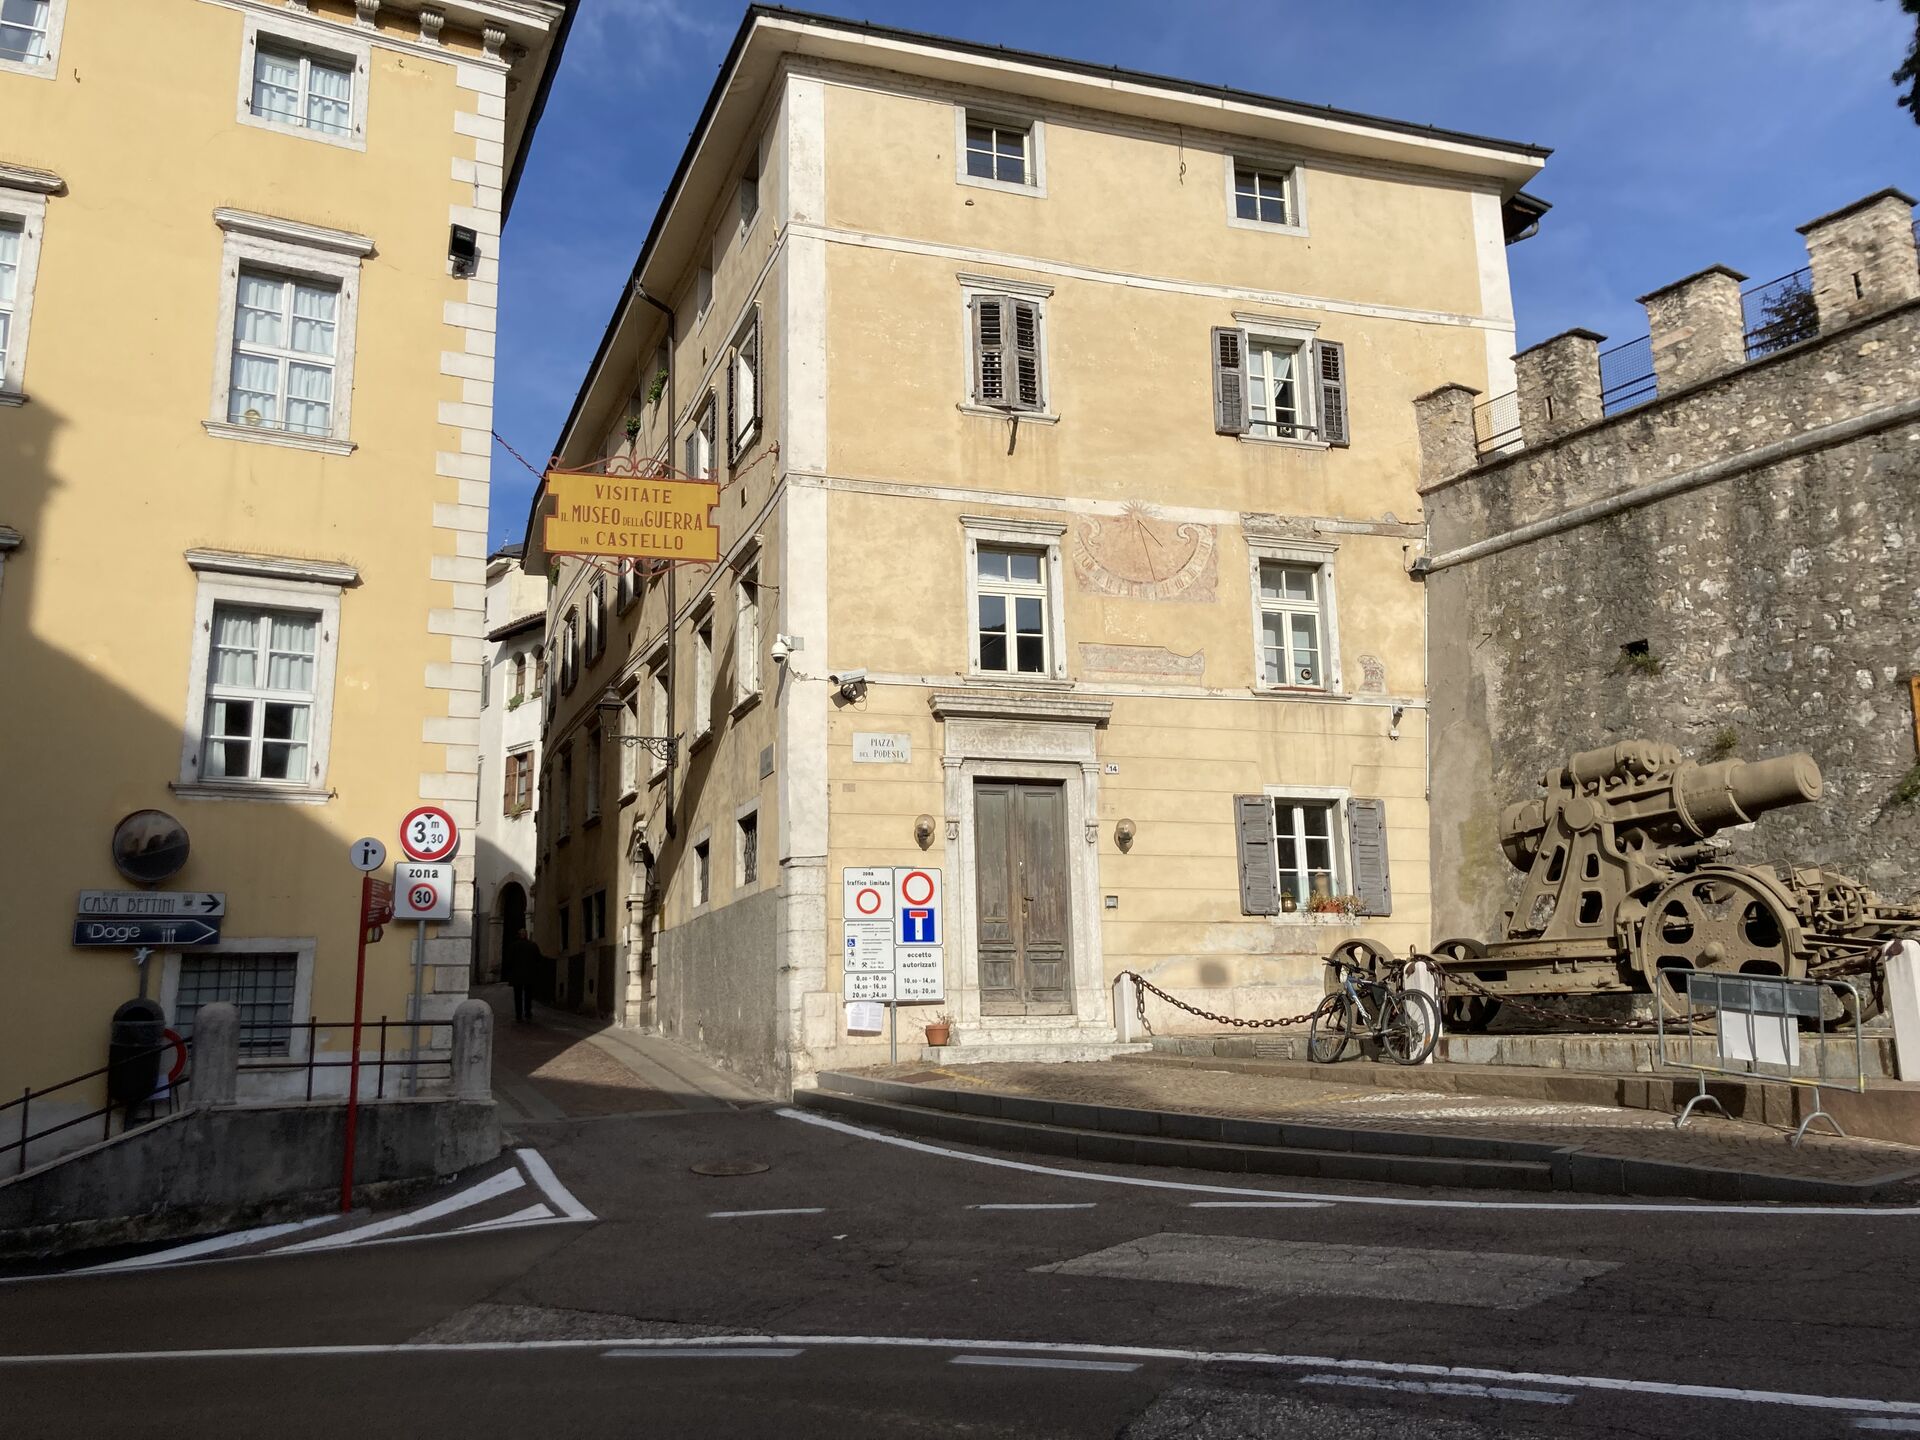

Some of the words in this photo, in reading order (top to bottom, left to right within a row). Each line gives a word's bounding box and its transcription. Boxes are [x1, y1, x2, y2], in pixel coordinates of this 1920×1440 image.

[595, 484, 672, 504] VISITATE
[561, 512, 569, 522] IL
[572, 505, 620, 525] MUSEO
[623, 516, 644, 527] DELLA
[644, 510, 703, 531] GUERRA
[580, 537, 589, 545] IN
[596, 531, 684, 550] CASTELLO
[870, 738, 895, 747] PIAZZA
[409, 868, 439, 879] zona
[83, 897, 120, 912] CASA
[127, 897, 176, 913] BETTINI
[415, 890, 432, 904] 30
[90, 923, 141, 942] Doge
